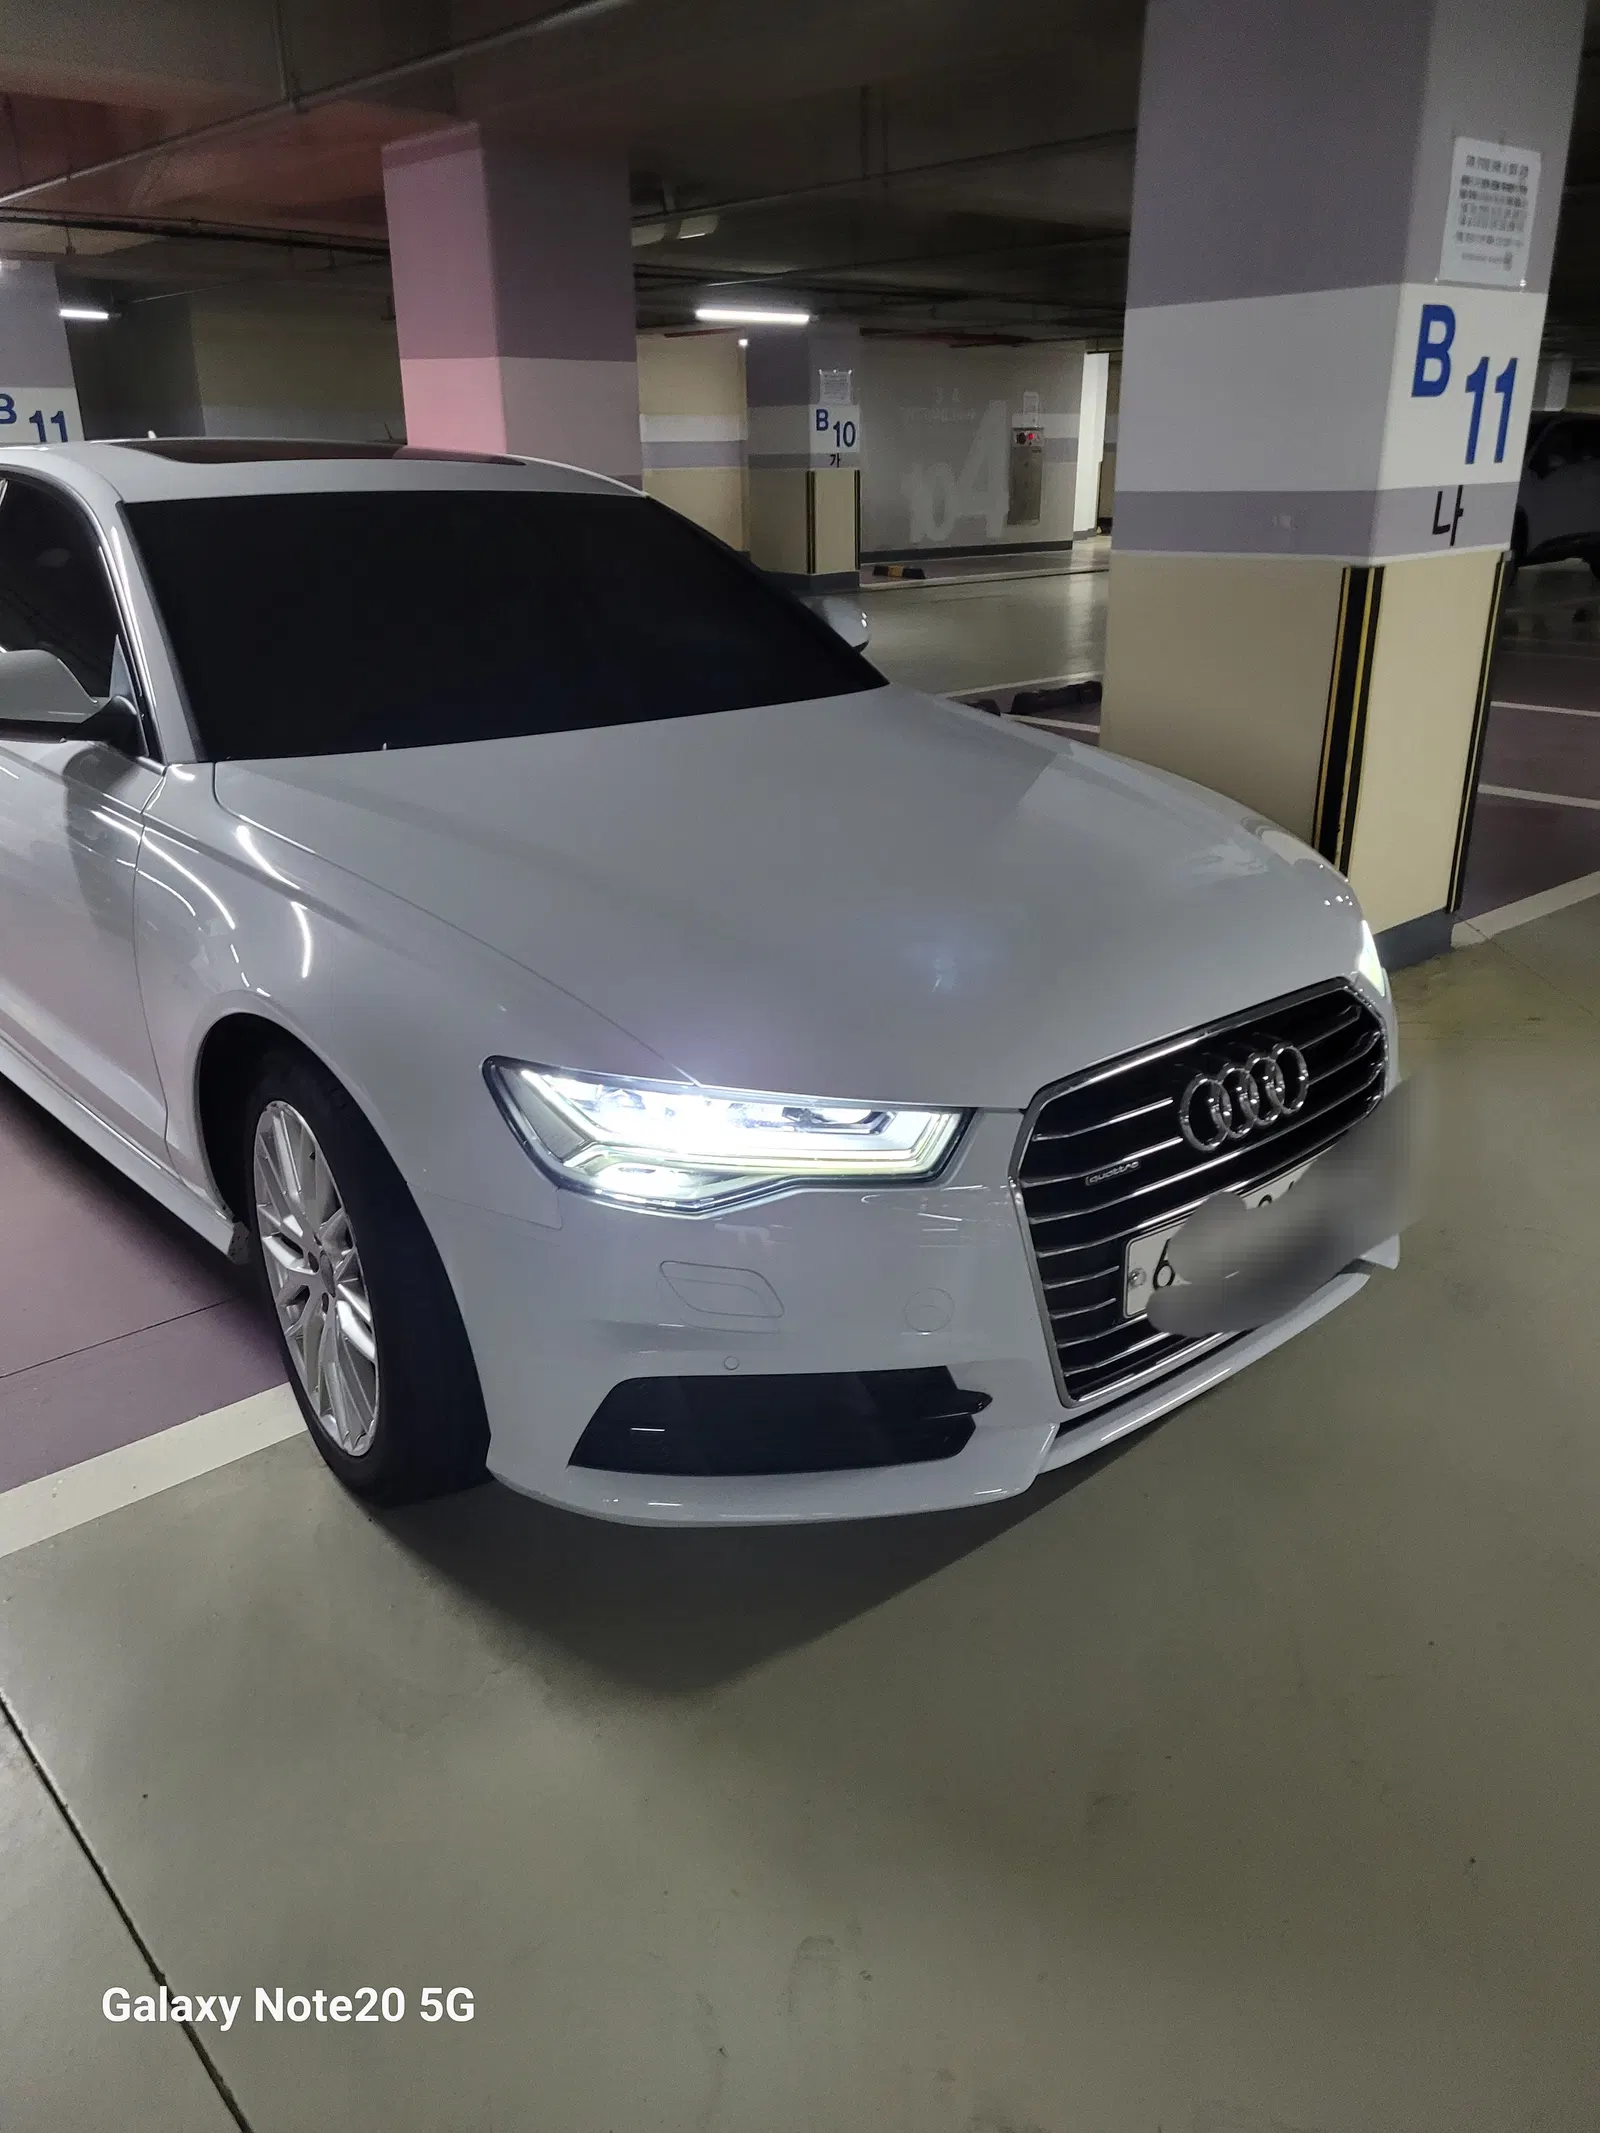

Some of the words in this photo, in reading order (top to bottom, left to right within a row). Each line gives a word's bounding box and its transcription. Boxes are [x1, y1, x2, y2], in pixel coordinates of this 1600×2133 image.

[1411, 304, 1456, 398] B
[1464, 356, 1519, 465] 11
[28, 410, 69, 442] 11
[815, 408, 829, 432] B
[833, 421, 856, 448] 10
[830, 452, 842, 468] 가
[1431, 485, 1464, 546] 나
[1089, 1160, 1140, 1185] quattro
